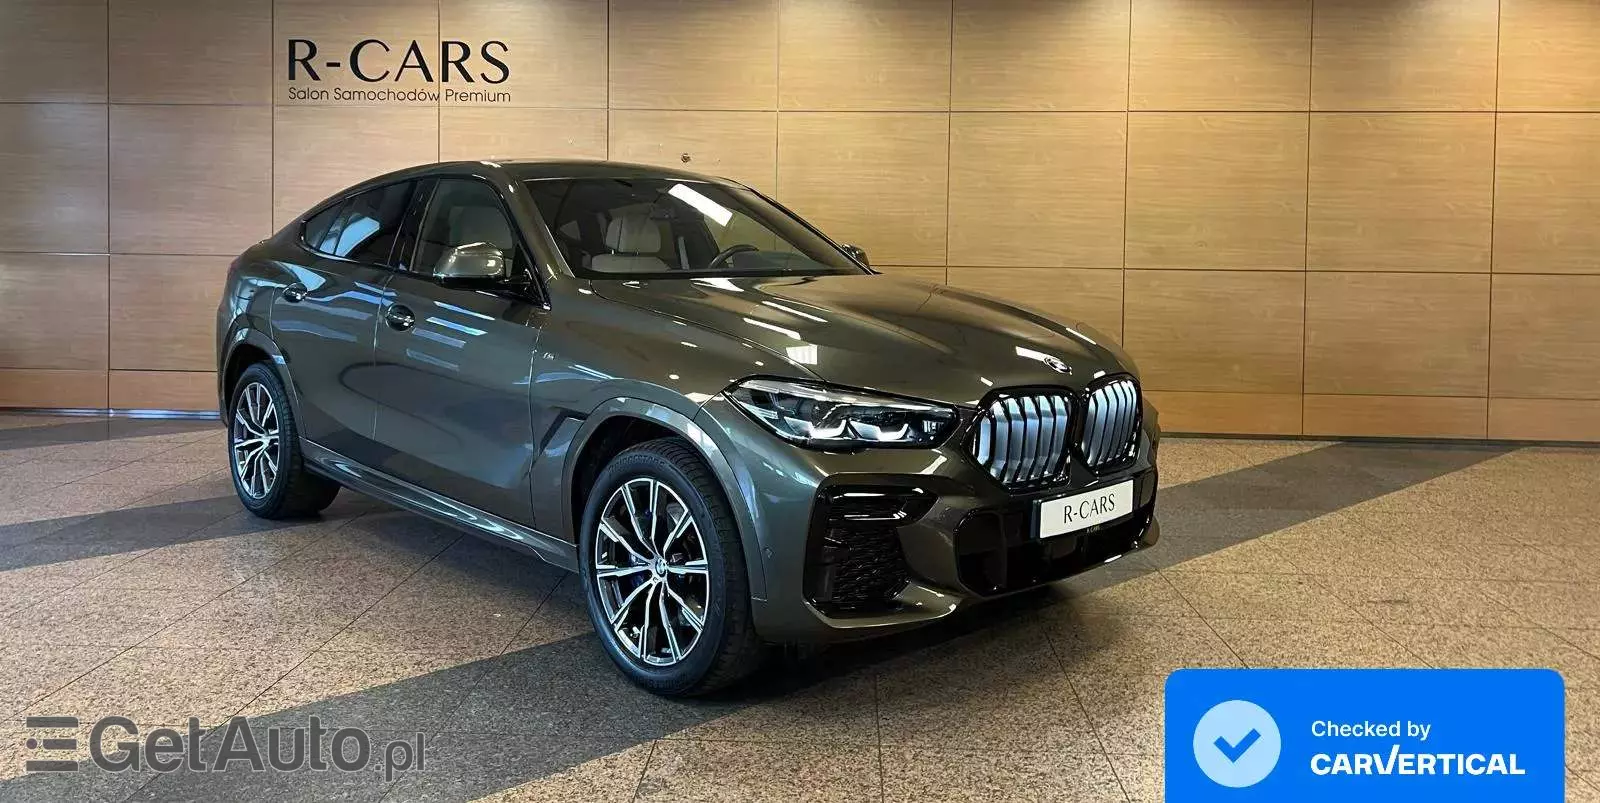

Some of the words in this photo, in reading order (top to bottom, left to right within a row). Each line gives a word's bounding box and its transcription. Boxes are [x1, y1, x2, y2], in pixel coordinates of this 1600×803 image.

[288, 39, 510, 84] R-CARS
[288, 87, 329, 101] Salon
[334, 88, 440, 102] Samochodów
[445, 89, 511, 102] Premium
[1063, 493, 1115, 523] R-CARS
